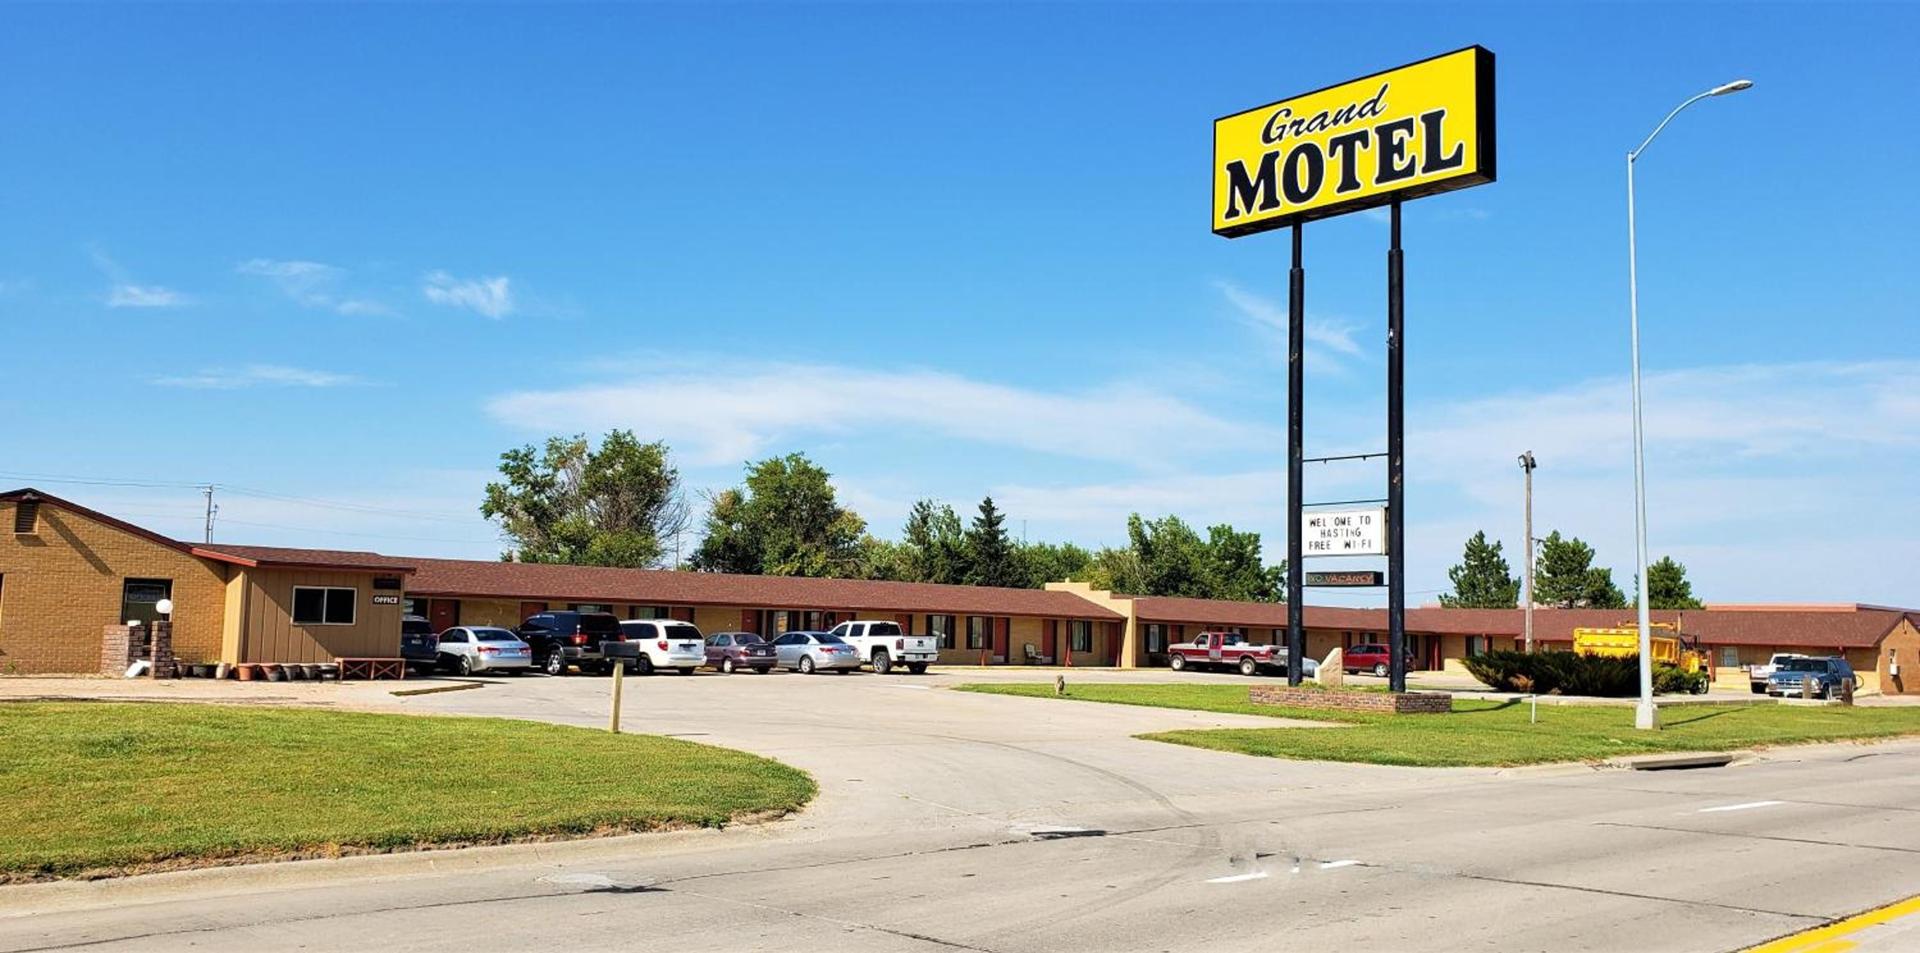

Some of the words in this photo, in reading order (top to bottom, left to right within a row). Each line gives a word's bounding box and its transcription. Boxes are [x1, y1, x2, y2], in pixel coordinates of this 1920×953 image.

[1262, 84, 1389, 144] Grand
[1225, 109, 1464, 219] MOTEL
[1309, 517, 1352, 527] WELOME
[1359, 515, 1371, 525] TO
[1320, 527, 1361, 538] HASTING
[1309, 540, 1331, 550] FREE
[1325, 574, 1372, 583] VACANCY
[374, 596, 398, 604] OFFICE
